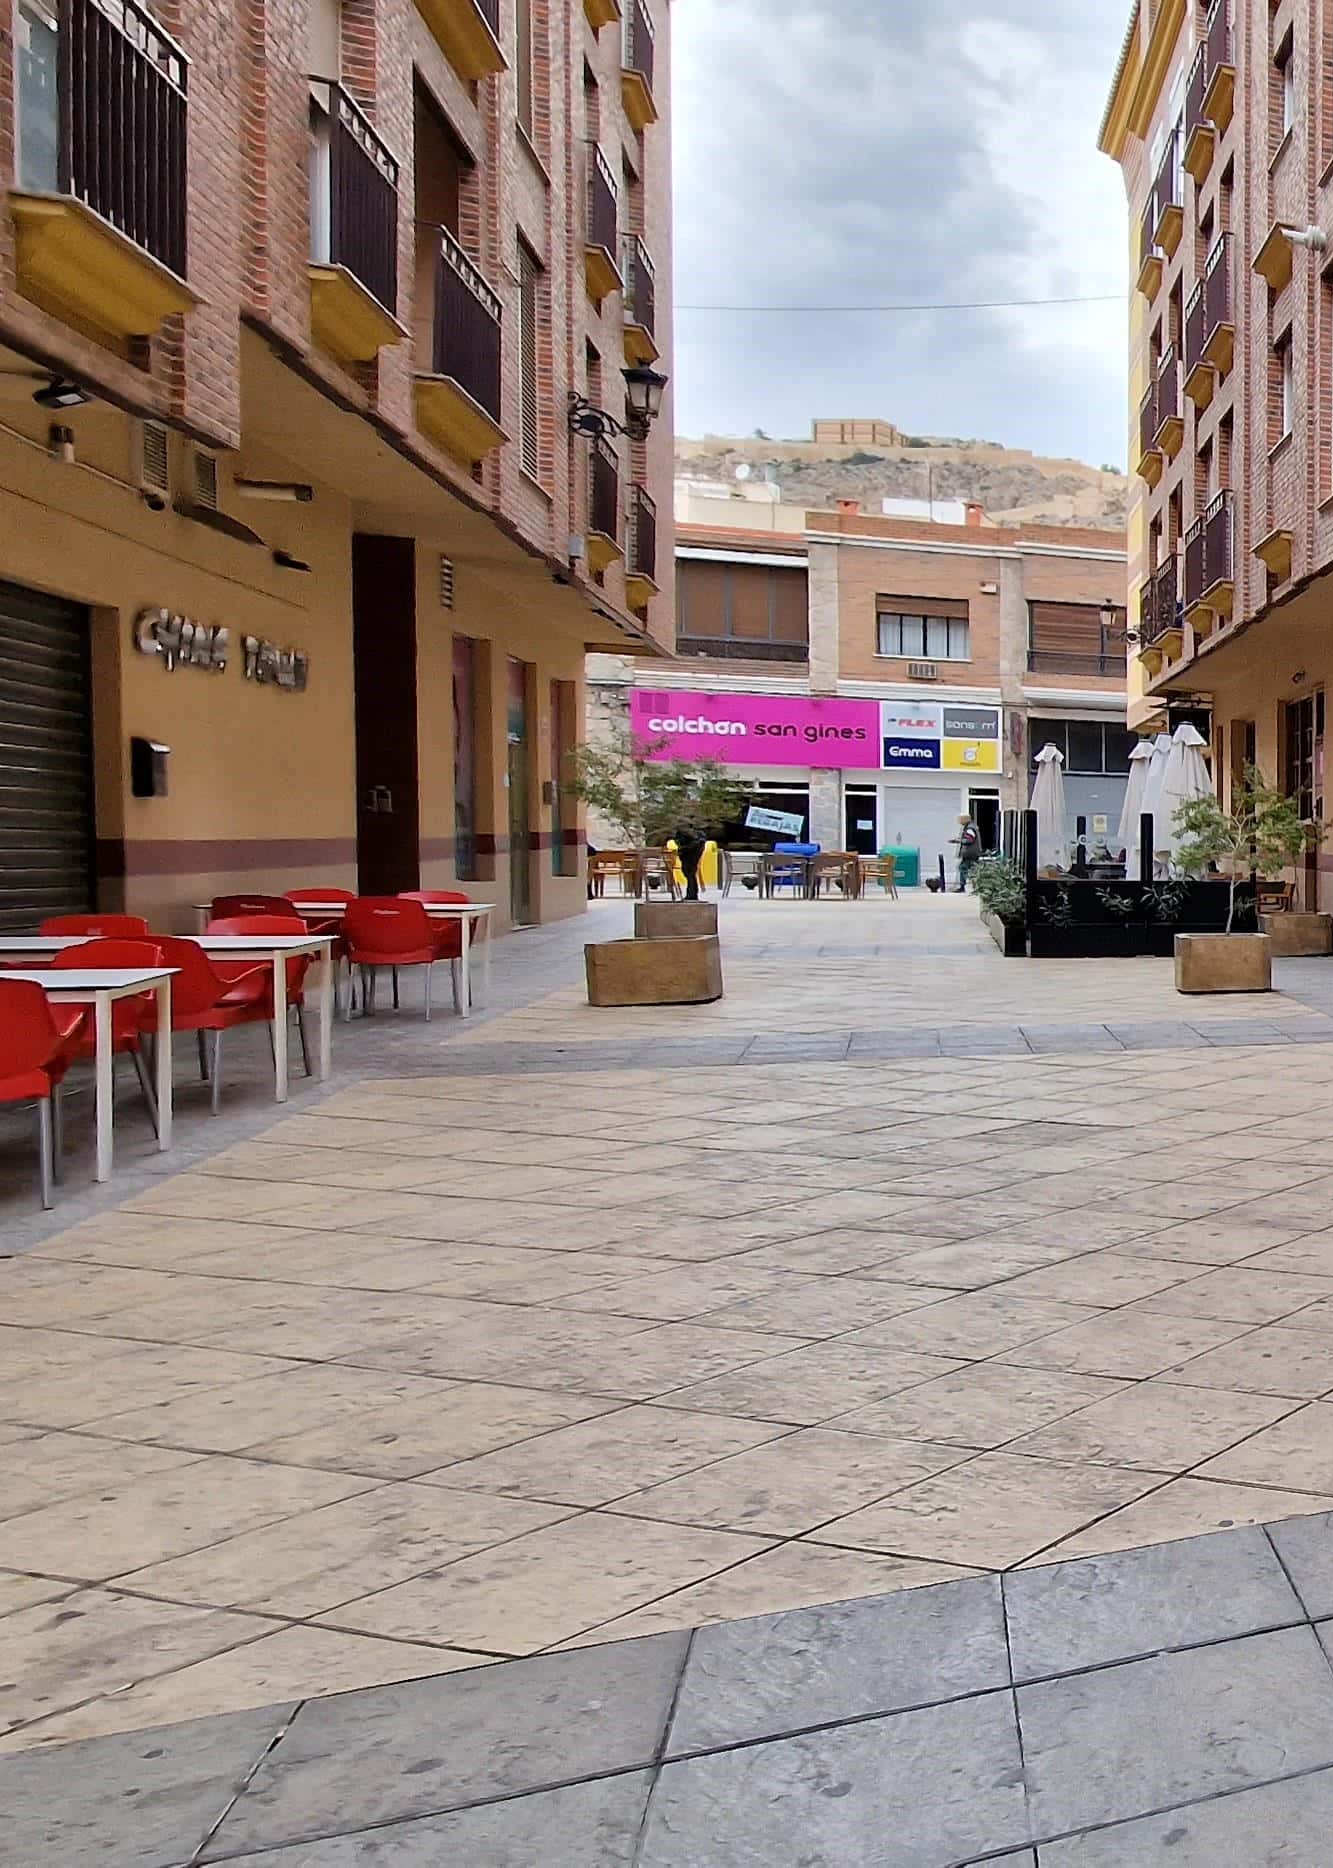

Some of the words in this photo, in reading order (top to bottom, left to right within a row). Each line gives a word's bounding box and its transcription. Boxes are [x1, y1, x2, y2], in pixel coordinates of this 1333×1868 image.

[898, 718, 937, 729] FLEX
[753, 723, 797, 737] san
[803, 722, 867, 743] gines
[889, 745, 934, 759] Emma
